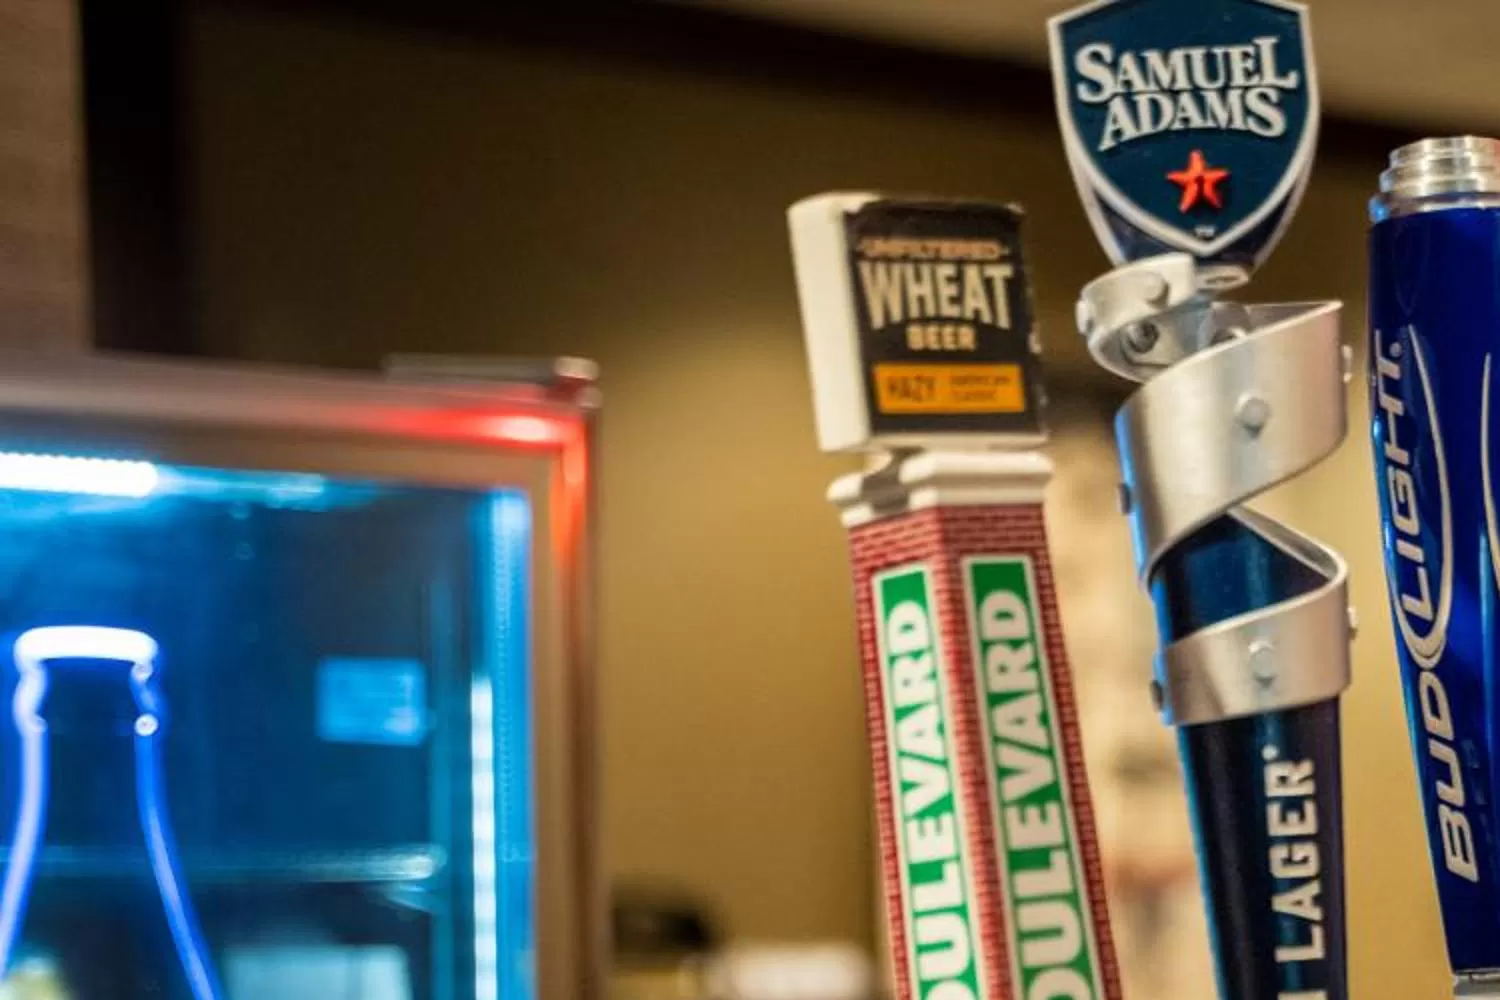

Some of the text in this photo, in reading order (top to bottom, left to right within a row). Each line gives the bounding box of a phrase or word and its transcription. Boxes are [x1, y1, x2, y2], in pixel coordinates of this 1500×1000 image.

[1075, 37, 1297, 103] SAMUEL
[1098, 87, 1287, 152] ADAMS
[858, 262, 1014, 331] WHEAT
[906, 322, 977, 351] BEER
[1419, 667, 1480, 883] BUD
[1264, 758, 1327, 963] LAGER
